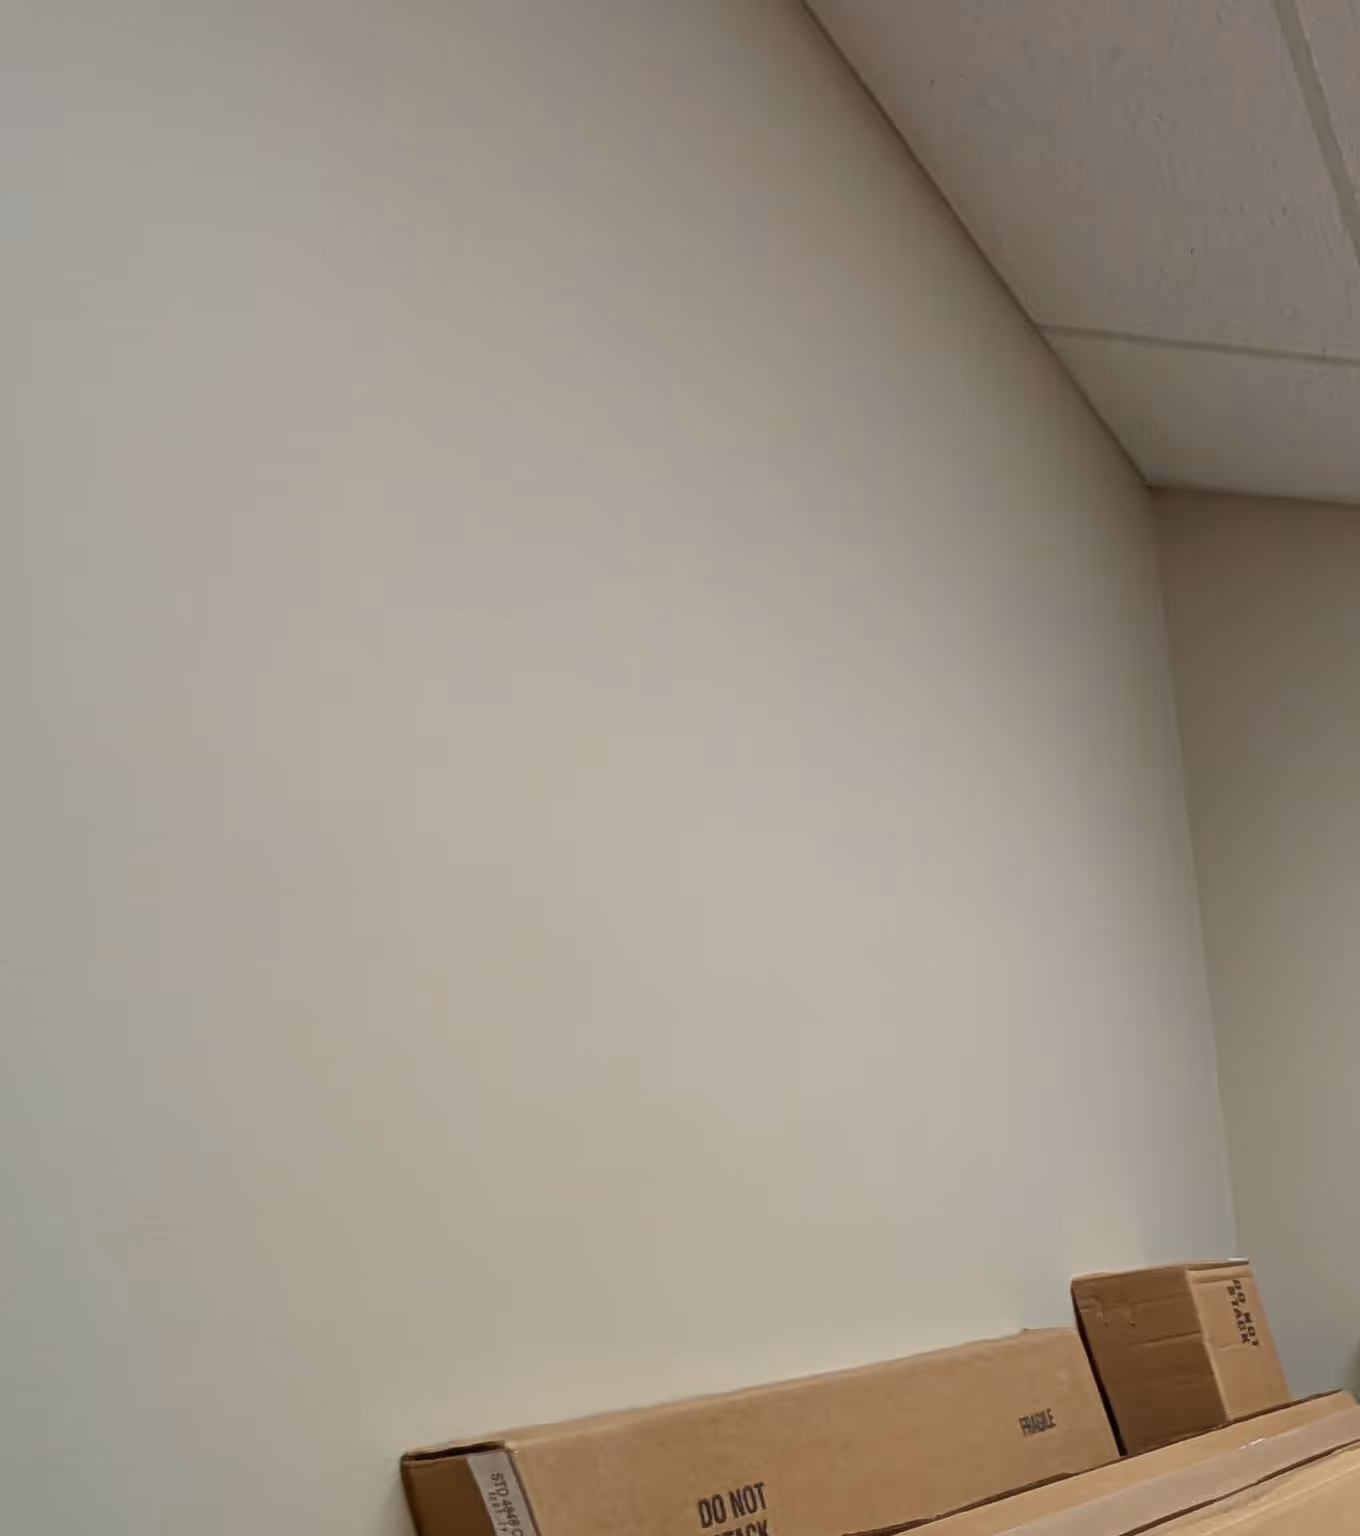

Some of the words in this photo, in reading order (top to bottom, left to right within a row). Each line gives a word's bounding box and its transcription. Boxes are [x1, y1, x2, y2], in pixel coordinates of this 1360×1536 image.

[1019, 1408, 1056, 1437] FRAGILE
[697, 1493, 727, 1529] DO
[728, 1481, 767, 1518] NOT
